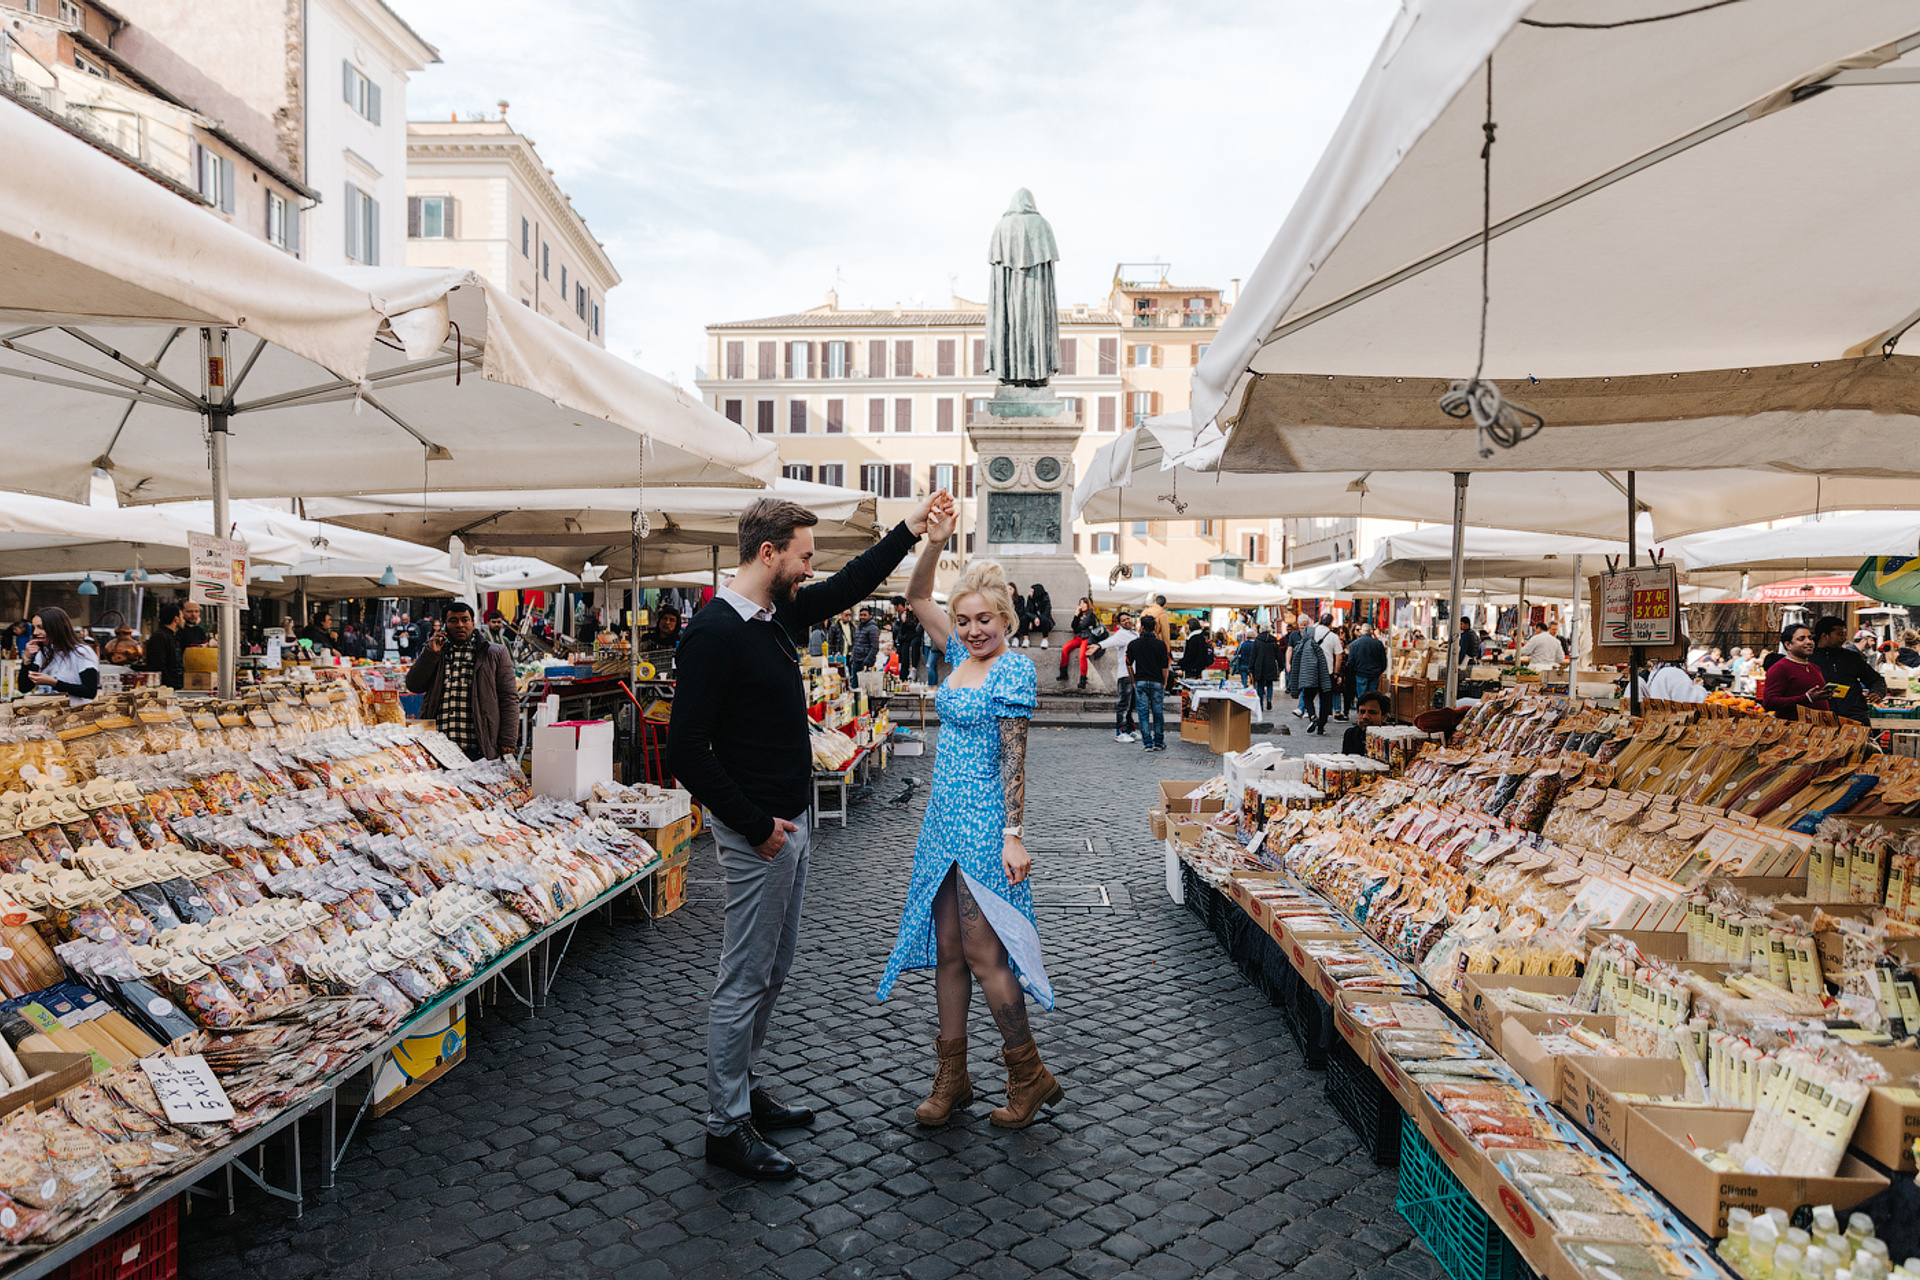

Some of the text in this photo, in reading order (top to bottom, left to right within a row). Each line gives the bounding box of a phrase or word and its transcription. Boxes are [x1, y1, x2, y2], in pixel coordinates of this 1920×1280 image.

[1814, 586, 1858, 597] ROMAN
[1637, 592, 1642, 602] 1
[1636, 606, 1642, 618] 3
[1653, 605, 1668, 617] 10€
[1634, 622, 1650, 630] Made
[1637, 630, 1652, 640] Italy
[1720, 1184, 1758, 1197] Cliente
